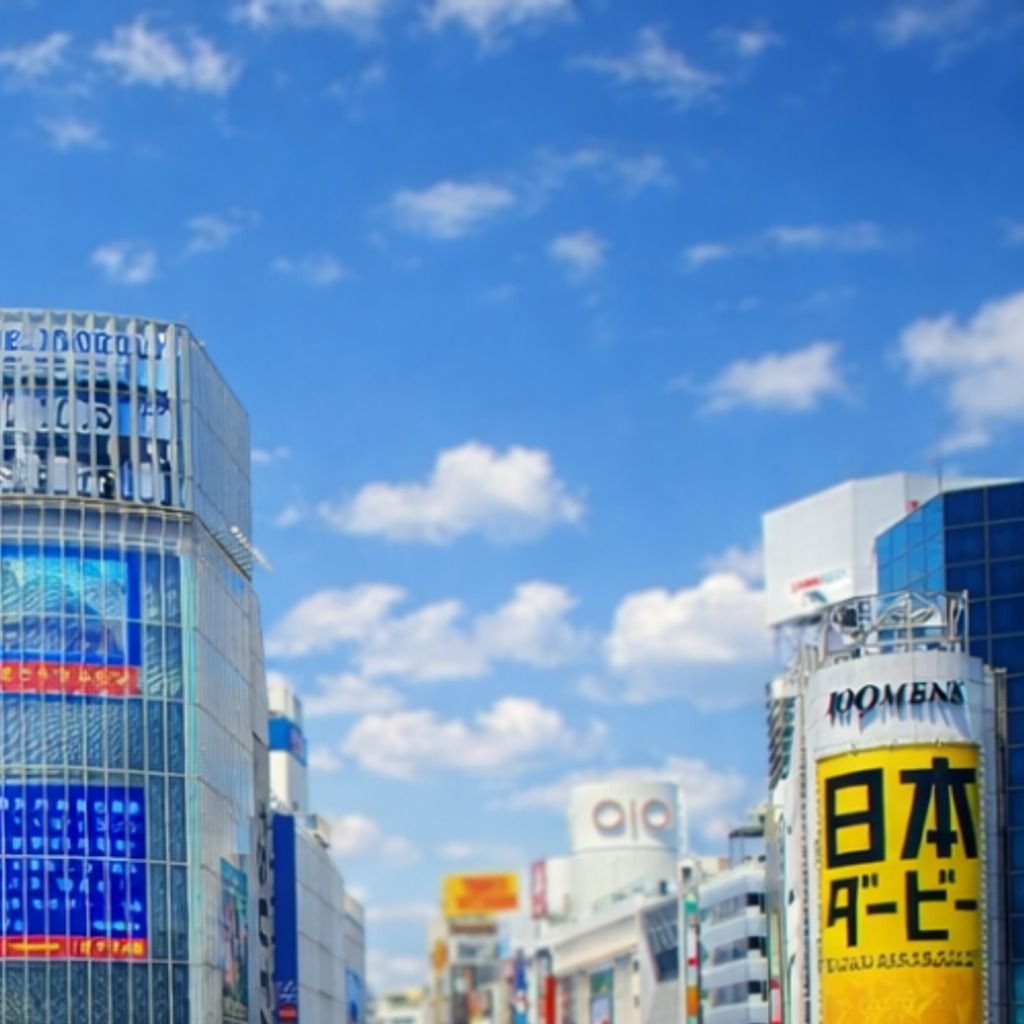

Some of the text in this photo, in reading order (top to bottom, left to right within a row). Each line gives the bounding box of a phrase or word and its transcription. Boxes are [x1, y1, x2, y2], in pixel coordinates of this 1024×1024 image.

[825, 757, 978, 869] 日本
[827, 869, 978, 947] ダービー
